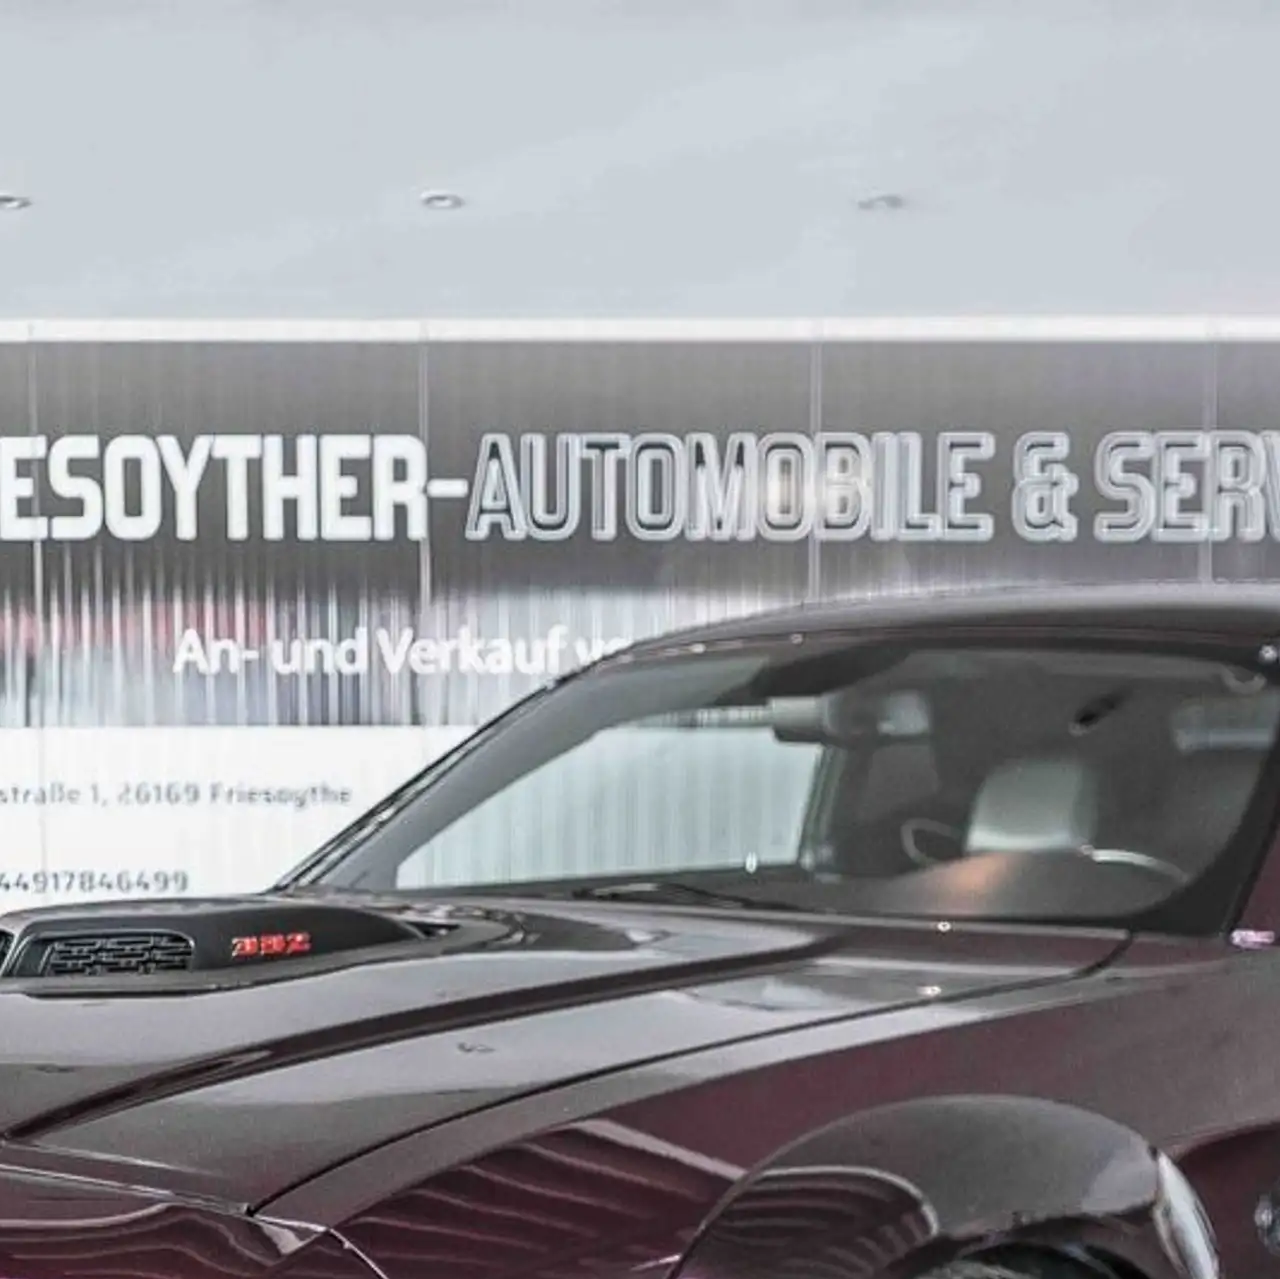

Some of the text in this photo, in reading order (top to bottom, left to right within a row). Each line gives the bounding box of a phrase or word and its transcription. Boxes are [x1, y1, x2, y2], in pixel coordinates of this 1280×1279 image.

[1011, 430, 1079, 543] &
[172, 627, 260, 675] An-
[271, 626, 368, 675] und
[375, 624, 569, 675] Verkauf
